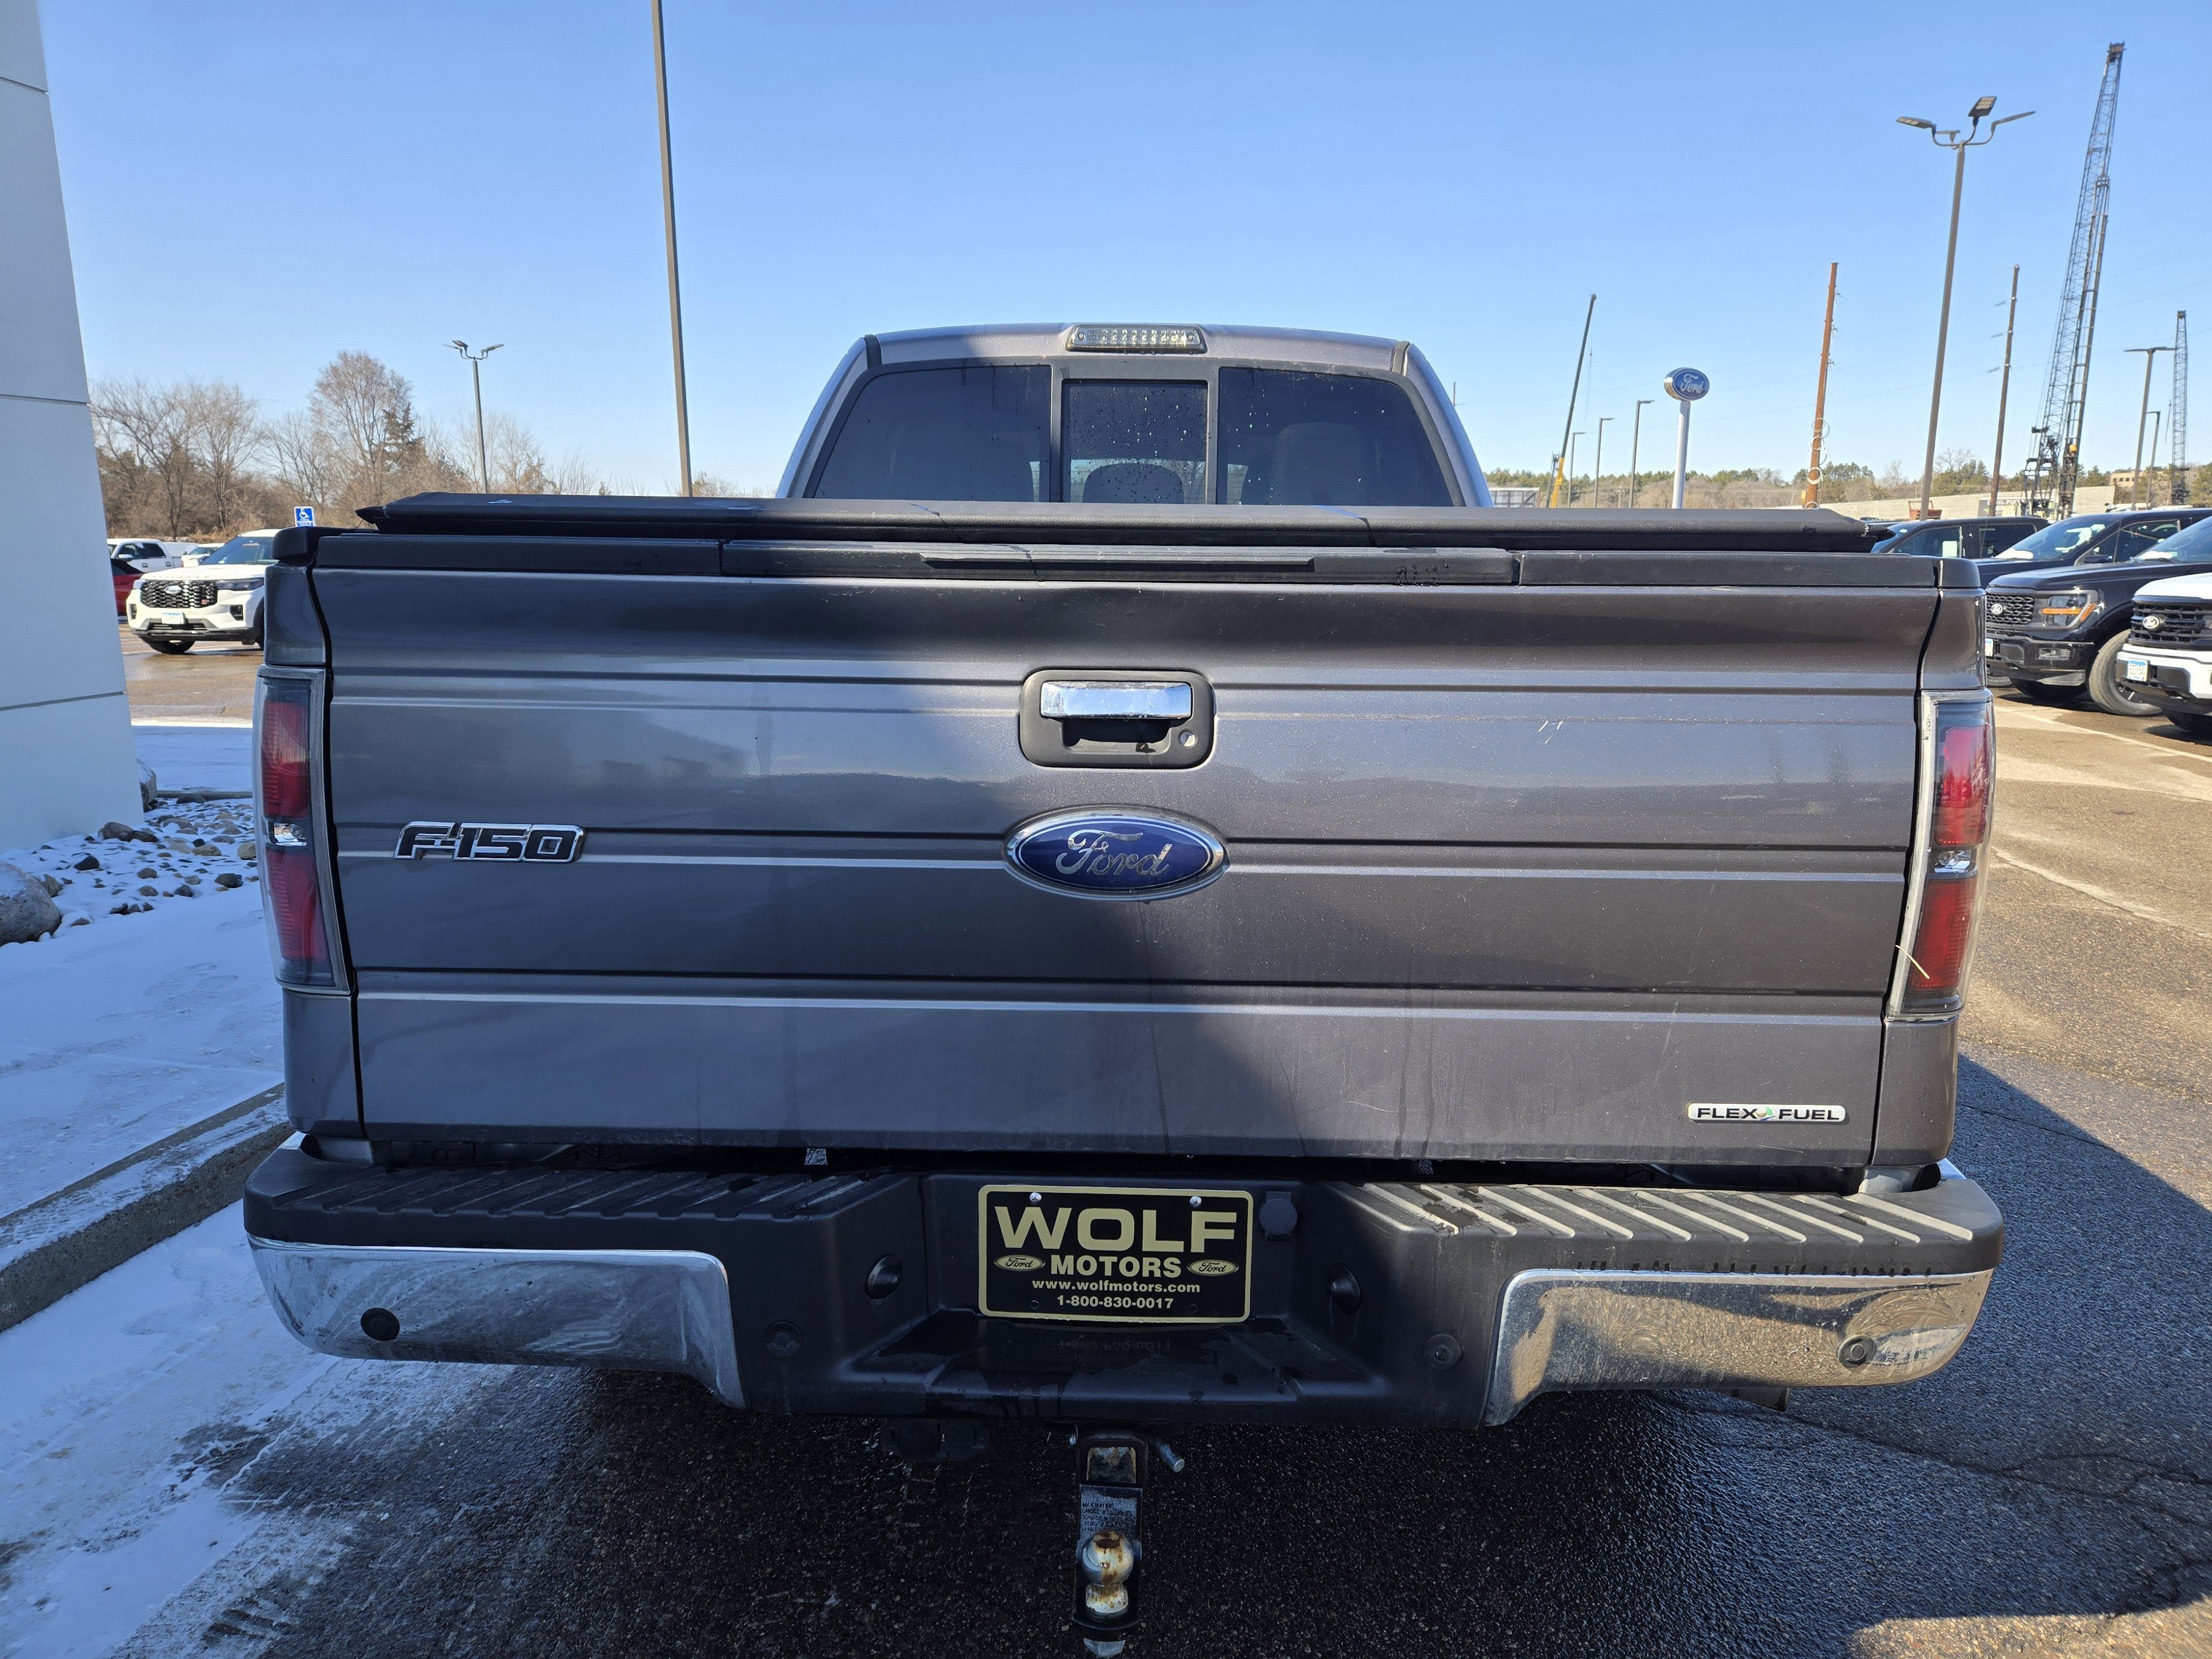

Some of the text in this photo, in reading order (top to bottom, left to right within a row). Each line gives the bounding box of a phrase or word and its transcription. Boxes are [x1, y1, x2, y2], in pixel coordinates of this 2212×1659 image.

[1680, 374, 1704, 394] Ford
[393, 821, 587, 863] F-150
[1056, 829, 1173, 875] Ford
[1697, 1108, 1839, 1120] FLEX FUEL
[994, 1206, 1237, 1253] WOLF
[1005, 1258, 1034, 1268] Ford
[1051, 1255, 1182, 1278] MOTORS
[1198, 1262, 1227, 1273] Ford
[1032, 1280, 1201, 1293] www.wolfmotors.com
[1057, 1296, 1173, 1309] 1-800-830-0017
